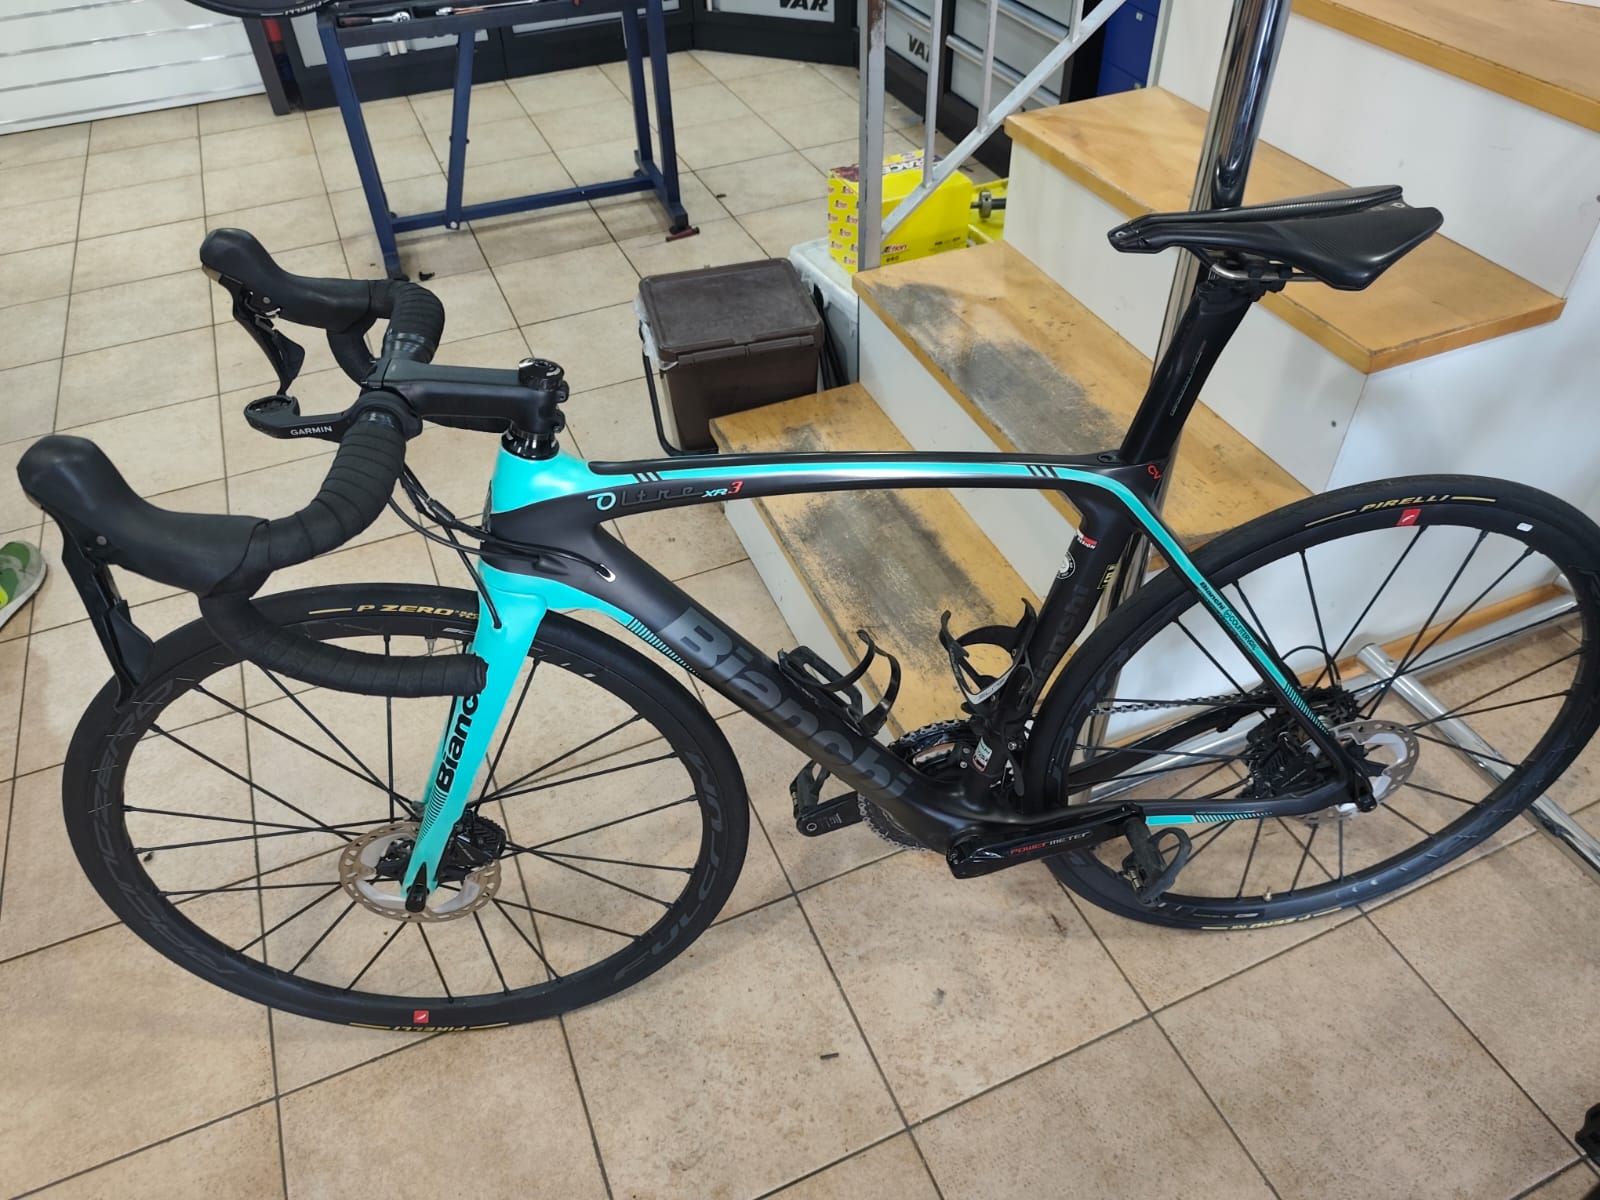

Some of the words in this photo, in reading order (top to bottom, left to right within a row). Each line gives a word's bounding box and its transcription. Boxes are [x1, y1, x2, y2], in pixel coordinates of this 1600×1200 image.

[290, 425, 333, 436] GARMIN
[1359, 494, 1451, 512] PIRELLI
[356, 604, 376, 612] P
[379, 604, 455, 616] ZERO
[657, 605, 914, 798] Bianchi
[435, 694, 479, 793] Bianc
